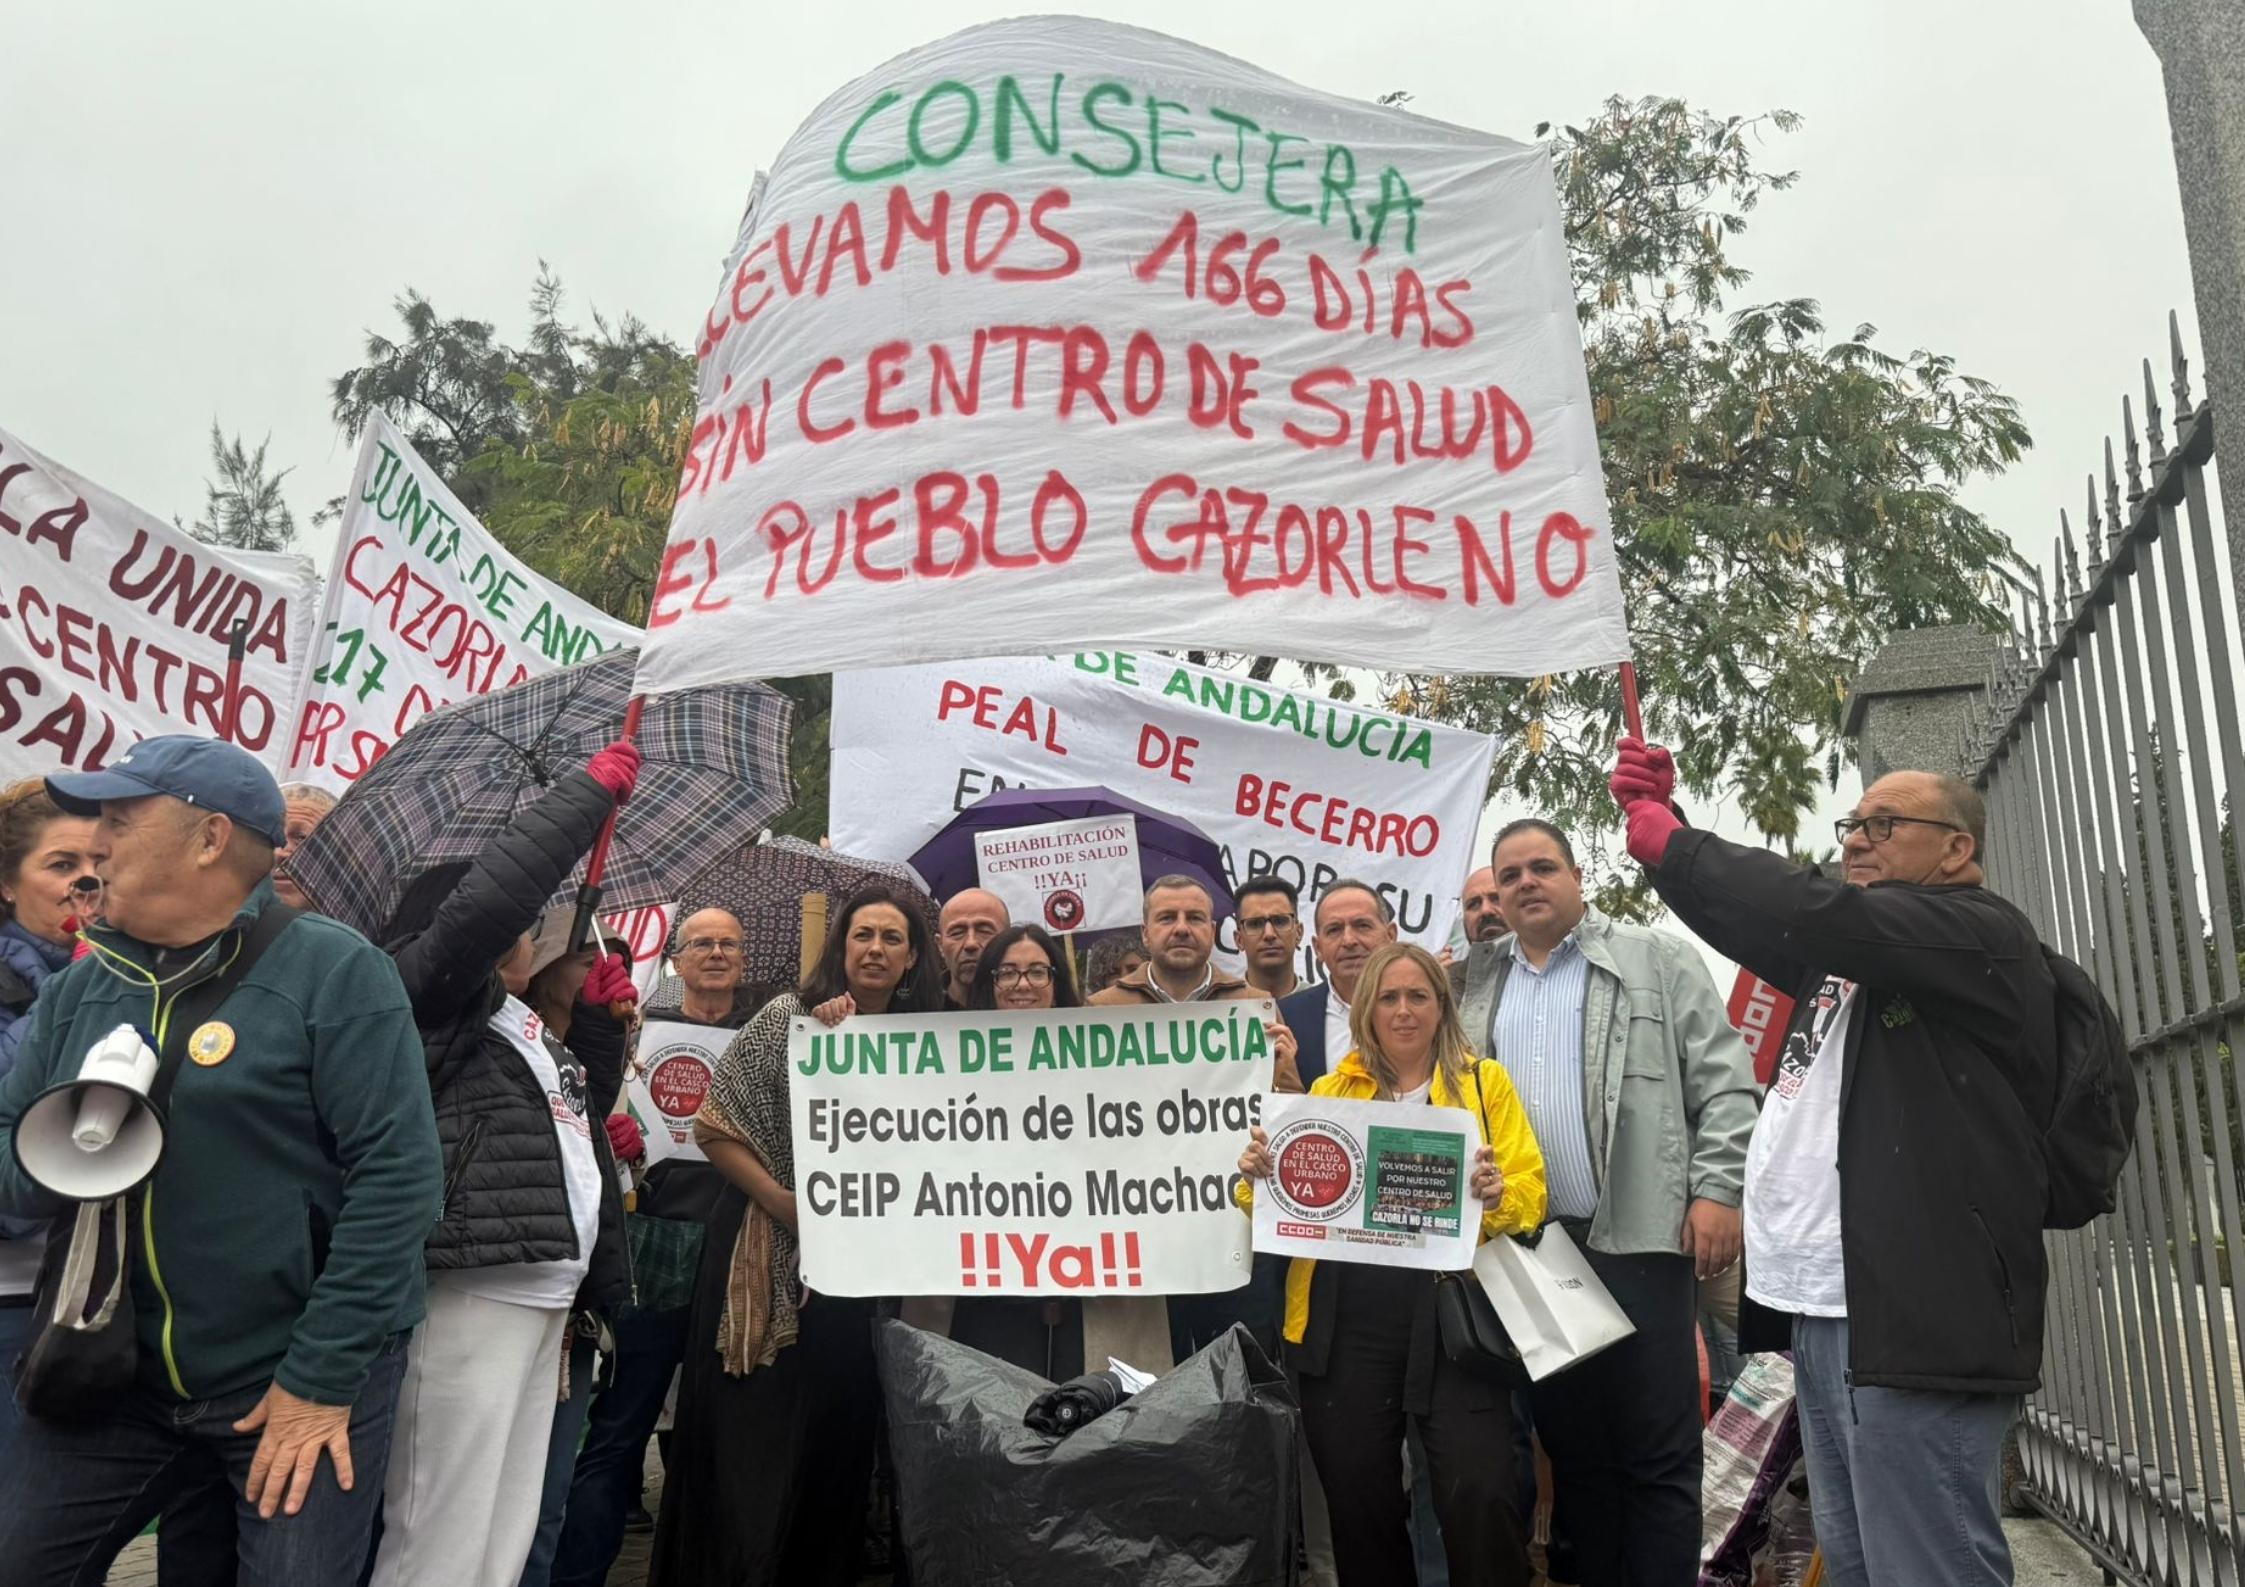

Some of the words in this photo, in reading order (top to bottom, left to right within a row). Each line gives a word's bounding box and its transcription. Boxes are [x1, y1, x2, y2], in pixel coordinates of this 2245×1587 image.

[836, 73, 1424, 253] CONSEJERA
[698, 186, 1081, 359] LEVAMOS
[1136, 211, 1286, 317] 166
[1309, 246, 1475, 350] DÍAS
[799, 326, 1165, 443] CENTRO
[1188, 343, 1260, 439] DE
[1284, 367, 1533, 472] SALUD
[361, 440, 469, 583] JUNTA
[469, 553, 528, 622] DE
[521, 601, 622, 666] AND
[649, 540, 730, 628] EL
[757, 470, 1087, 599] PUEBLO
[109, 529, 287, 664] UNIDA
[937, 680, 1068, 755] PEAL
[1137, 723, 1199, 784] DE
[1235, 773, 1439, 858] BECERRO
[982, 826, 1127, 857] REHABILITACIÓN
[988, 856, 1050, 873] CENTRO
[1054, 851, 1074, 865] DE
[1078, 845, 1129, 862] SALUD
[798, 1031, 945, 1076] JUNTA
[959, 1028, 1014, 1074] DE
[1029, 1007, 1267, 1071] ANDALUCÍA
[663, 1069, 674, 1077] DE
[677, 1070, 705, 1079] SALUD
[667, 1062, 702, 1072] CENTRO
[663, 1085, 701, 1095] URBANO
[669, 1077, 677, 1085] EL
[681, 1078, 709, 1088] CASCO
[660, 1094, 679, 1109] YA
[809, 1092, 1009, 1154] Ejecución
[1022, 1095, 1075, 1141] de
[1087, 1093, 1144, 1140] las
[1156, 1089, 1262, 1133] obras
[1295, 1141, 1336, 1153] CENTRO
[1292, 1151, 1305, 1160] DE
[1308, 1152, 1341, 1162] SALUD
[1283, 1159, 1296, 1169] EN
[1299, 1160, 1310, 1169] EL
[1312, 1161, 1346, 1172] CASCO
[1378, 1161, 1423, 1173] VOLVEMOS
[1431, 1166, 1456, 1175] SALIR
[1294, 1170, 1337, 1180] URBANO
[1386, 1174, 1405, 1183] POR
[1406, 1176, 1446, 1187] NUESTRO
[806, 1171, 901, 1217] CEIP
[913, 1171, 1073, 1217] Antonio
[1291, 1181, 1314, 1198] YA
[1378, 1186, 1411, 1196] CENTRO
[1412, 1189, 1422, 1197] DE
[1424, 1190, 1452, 1199] SALUD
[1372, 1212, 1407, 1224] CAZORLA
[1409, 1214, 1420, 1225] NO
[1422, 1216, 1433, 1227] SE
[1434, 1217, 1458, 1229] RINDE
[1347, 1228, 1376, 1237] DEFENSA
[960, 1232, 1143, 1288] !!Ya!!
